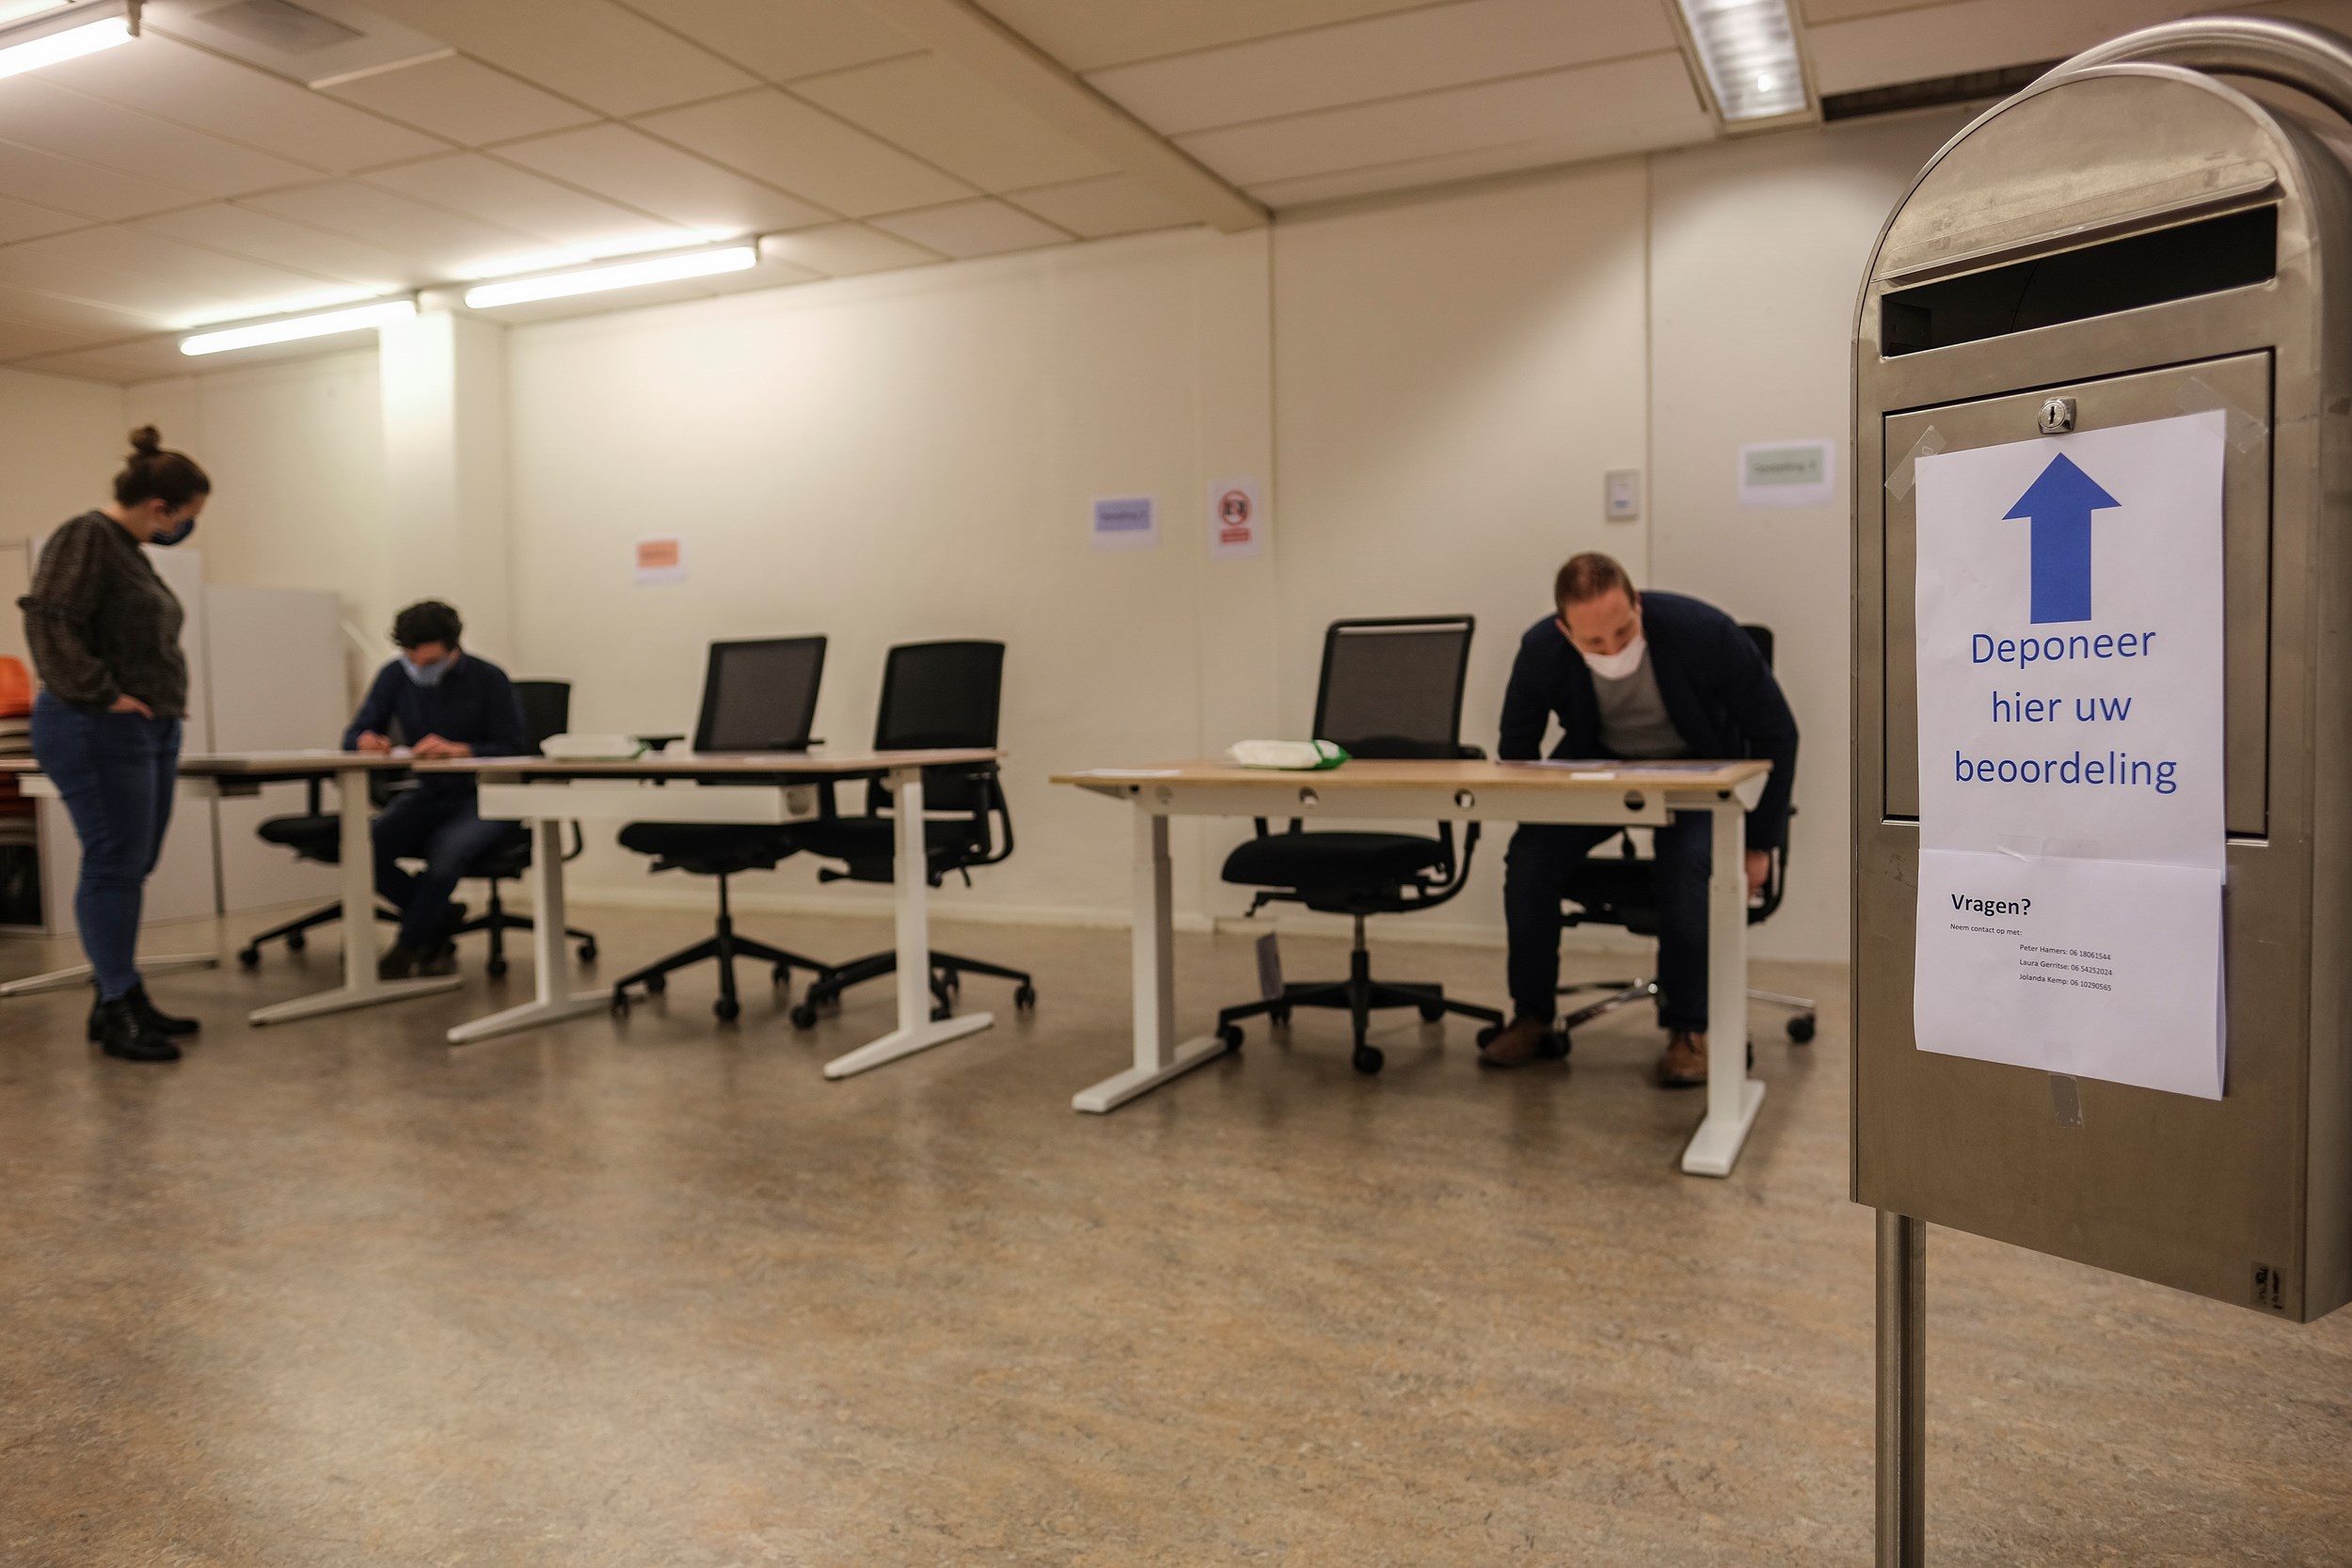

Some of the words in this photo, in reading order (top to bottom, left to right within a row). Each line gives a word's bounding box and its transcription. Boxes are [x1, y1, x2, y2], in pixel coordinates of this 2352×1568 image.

[1973, 631, 2156, 670] Deponeer
[1993, 690, 2062, 722] hier
[2075, 696, 2132, 722] uw
[1956, 751, 2177, 795] beoordeling
[1951, 894, 2031, 917] Vragen?
[2019, 943, 2038, 952] Peter
[2039, 946, 2068, 955] Hamers:
[2040, 960, 2070, 971] Gerritse:
[2080, 965, 2112, 976] 54252024
[2019, 974, 2045, 982] Jolanda
[2047, 976, 2069, 986] Kemp:
